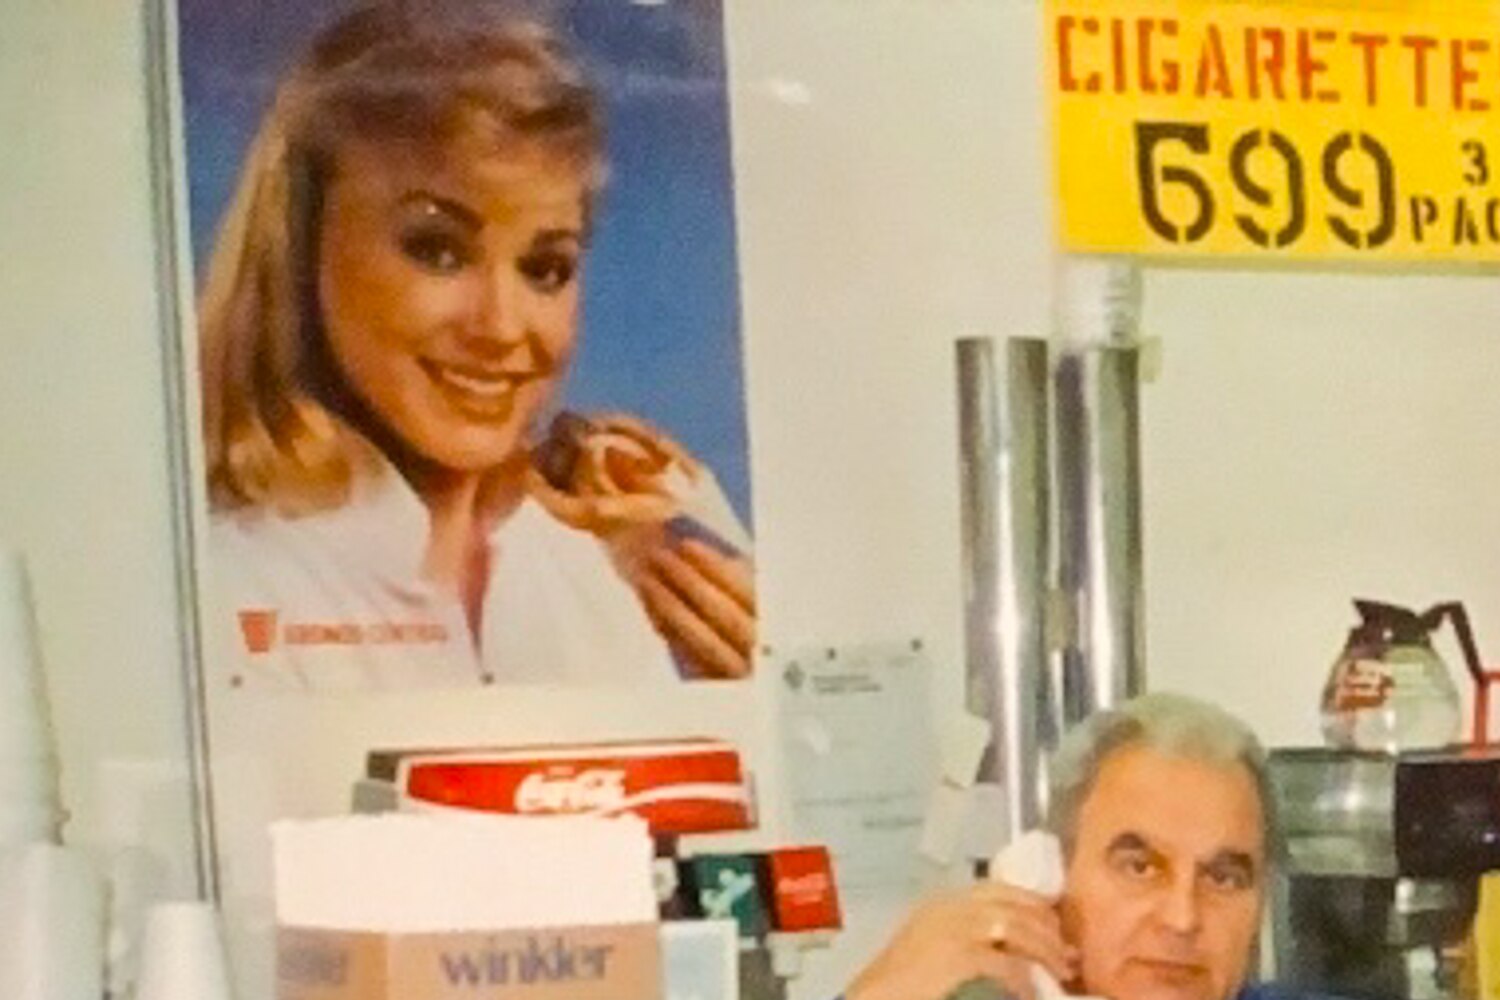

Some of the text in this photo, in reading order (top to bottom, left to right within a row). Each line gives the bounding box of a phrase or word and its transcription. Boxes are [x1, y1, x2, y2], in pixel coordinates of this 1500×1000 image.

[1133, 121, 1491, 250] 699 3
[439, 935, 615, 986] winkler
